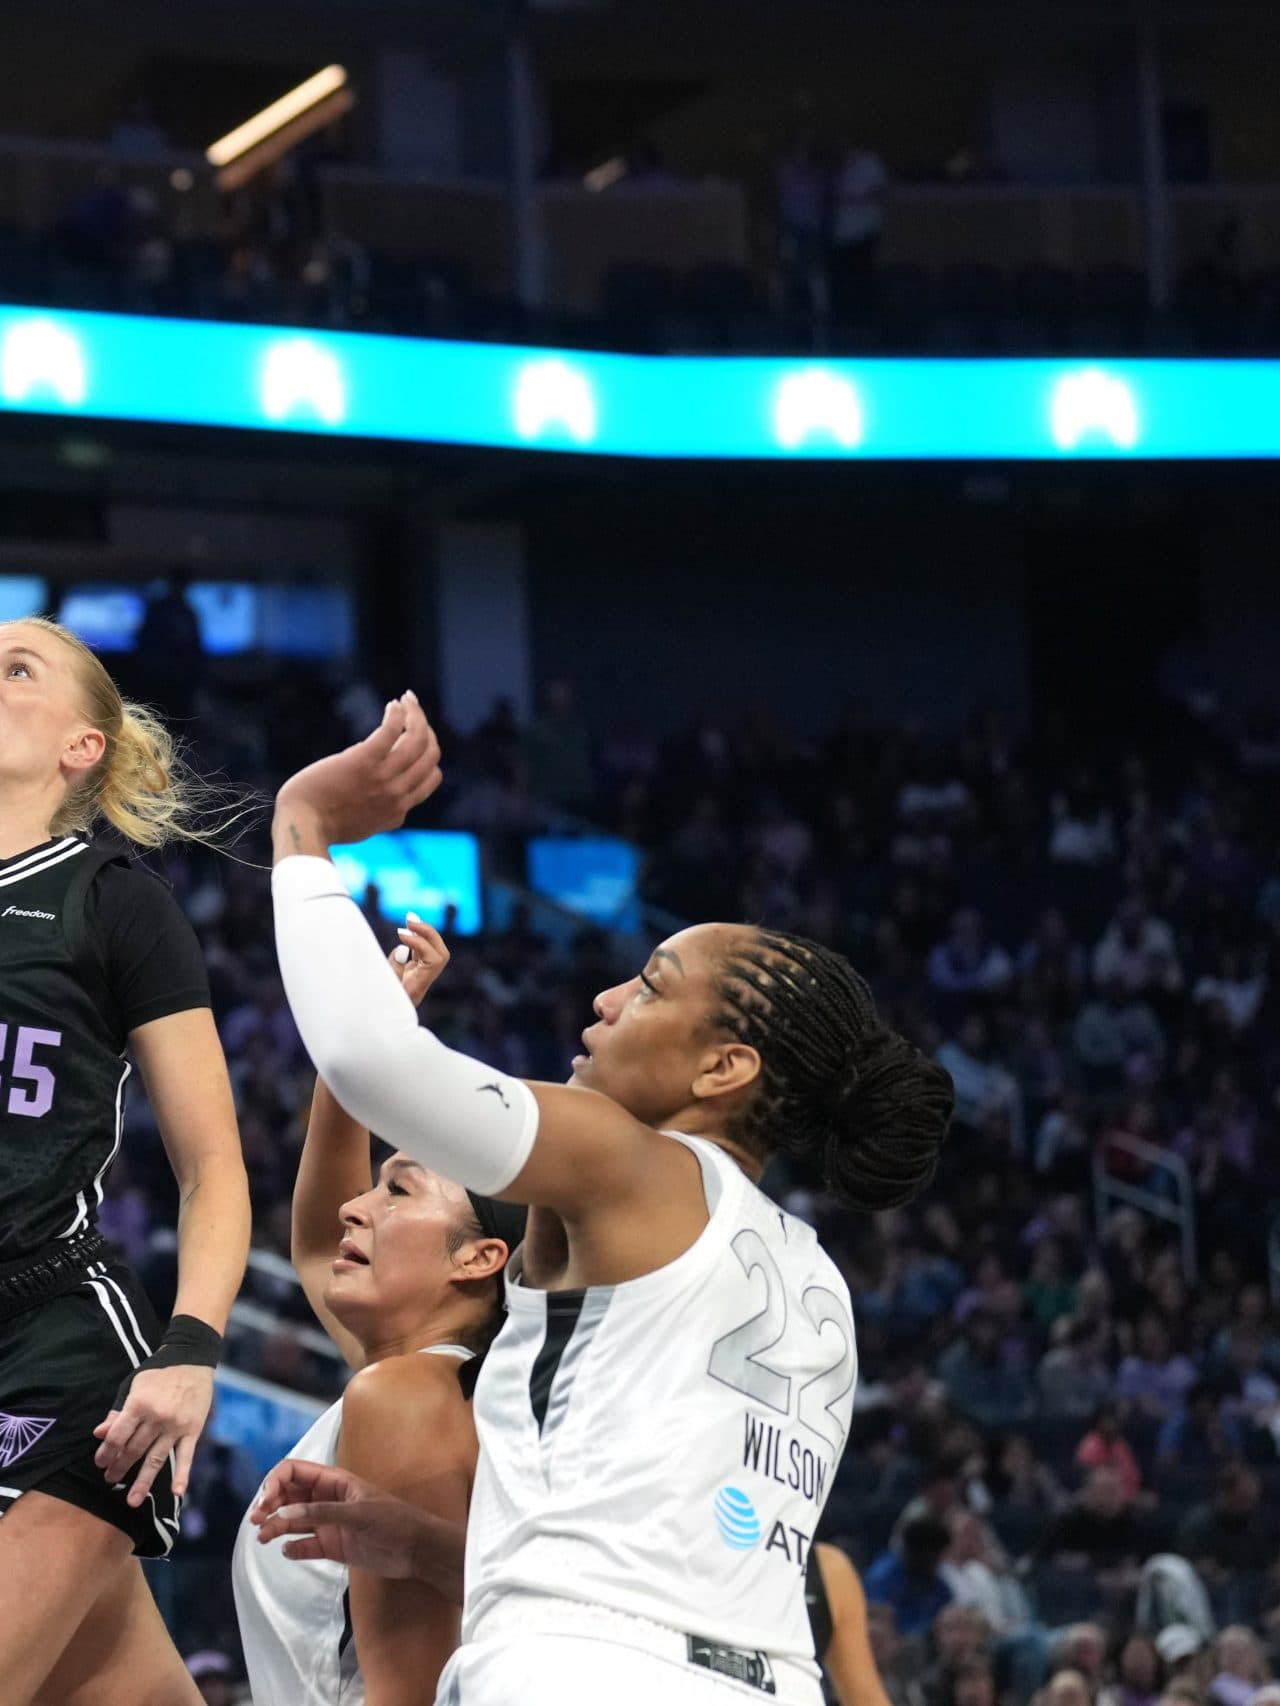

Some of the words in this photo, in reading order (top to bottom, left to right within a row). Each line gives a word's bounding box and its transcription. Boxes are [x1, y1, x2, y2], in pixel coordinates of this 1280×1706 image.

[1, 905, 56, 921] freedom
[707, 1228, 858, 1469] 22
[743, 1412, 827, 1507] WILSON
[765, 1520, 809, 1577] AT
